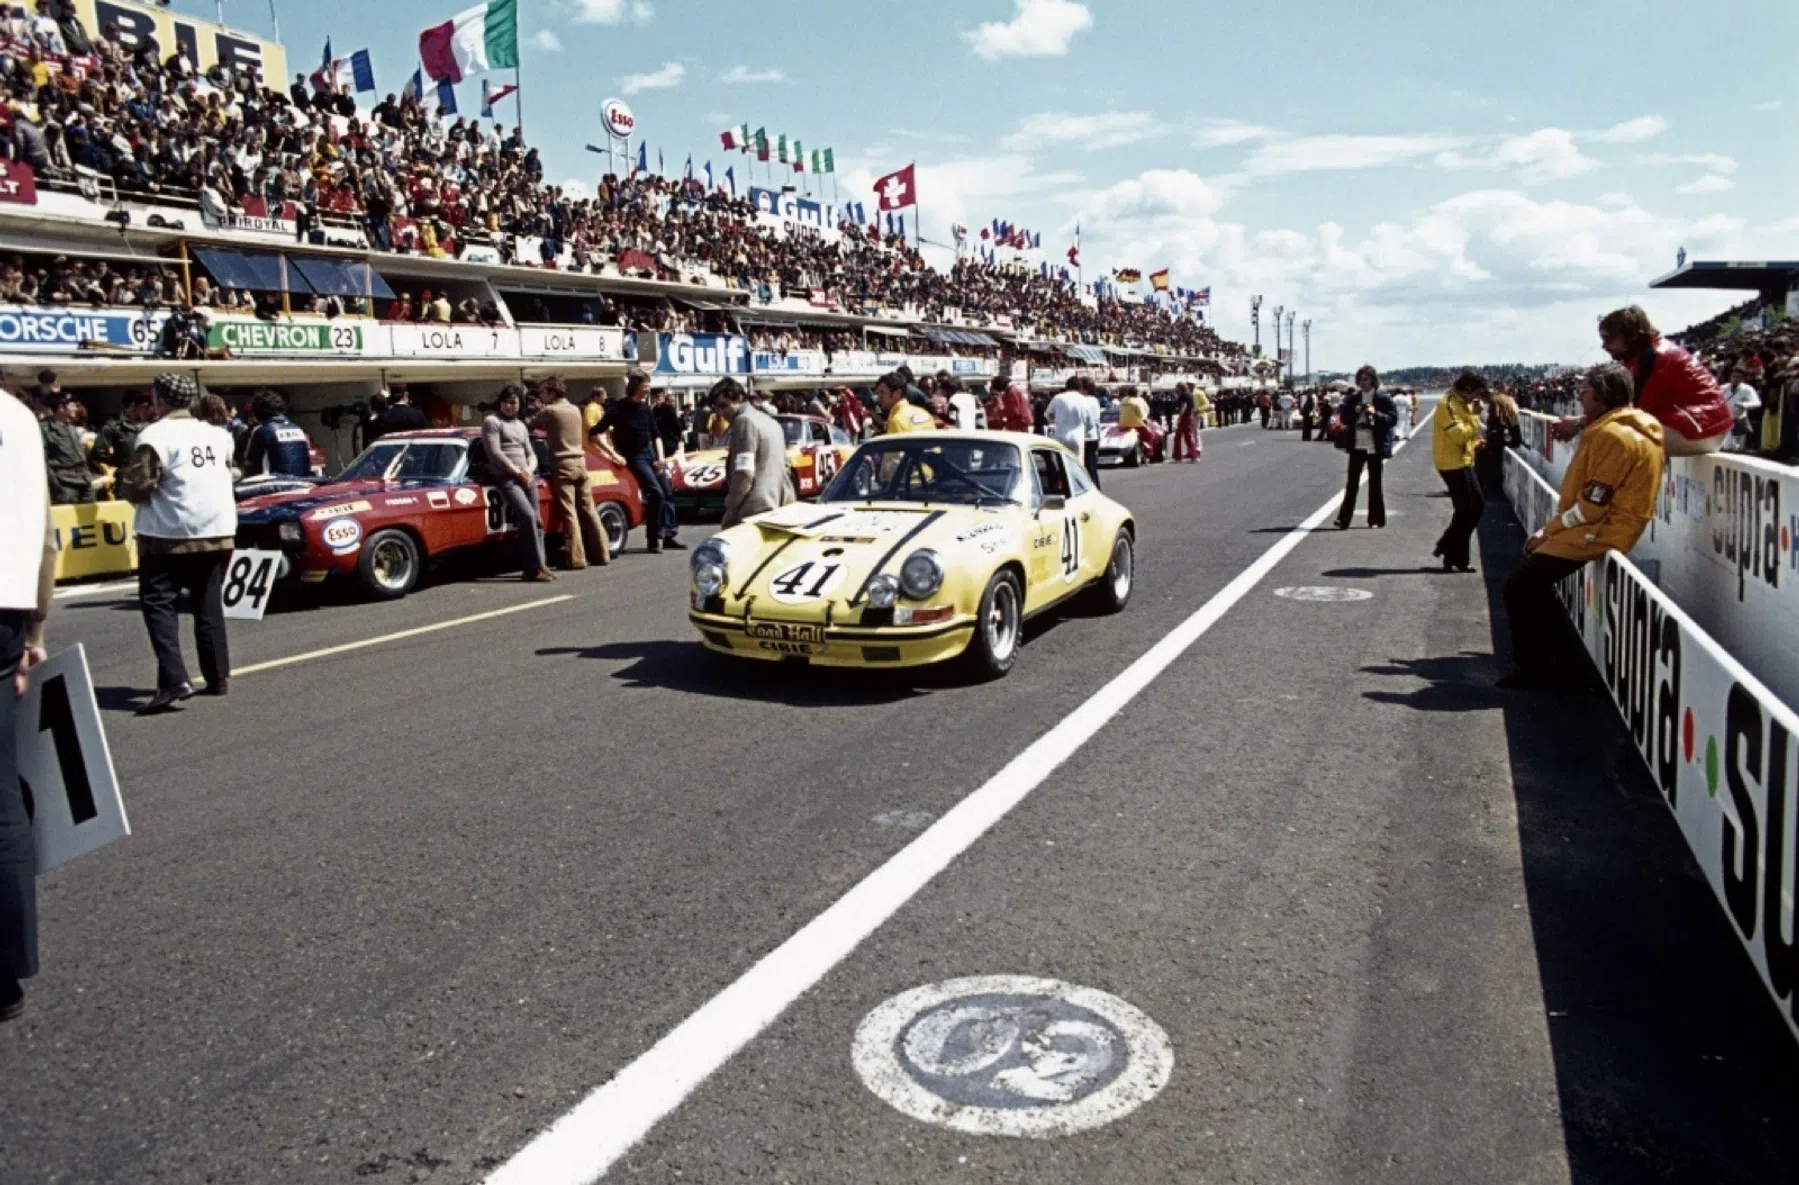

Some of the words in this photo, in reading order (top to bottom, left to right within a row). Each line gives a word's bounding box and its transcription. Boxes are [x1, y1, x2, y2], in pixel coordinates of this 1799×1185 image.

[611, 108, 634, 128] Esso
[133, 320, 160, 343] 65
[221, 324, 320, 348] CHEVRON
[334, 328, 353, 349] 23
[422, 331, 463, 349] LOLA
[491, 331, 499, 350] 7
[544, 335, 576, 350] LOLA
[599, 336, 606, 351] 8
[668, 333, 745, 373] Gulf
[191, 445, 216, 467] 84
[688, 465, 722, 484] 45
[1062, 516, 1078, 576] 41
[1713, 465, 1779, 603] supra
[223, 556, 273, 609] 84
[773, 561, 841, 598] 41
[1604, 556, 1682, 811] supra
